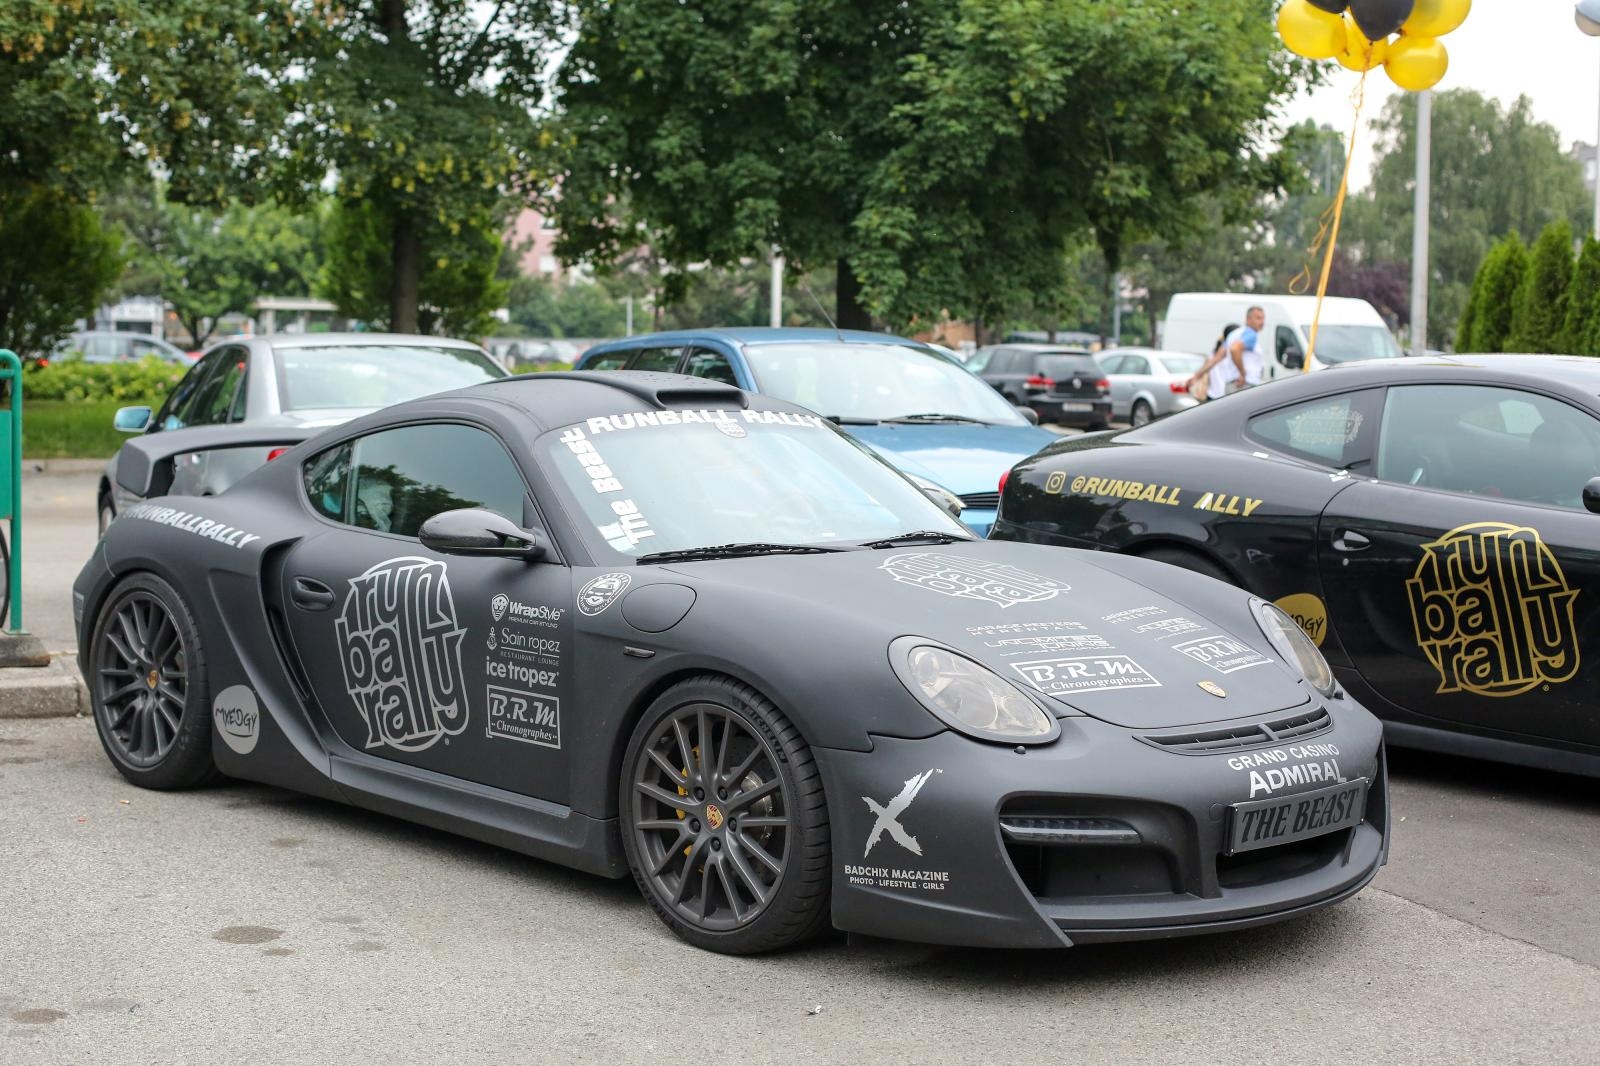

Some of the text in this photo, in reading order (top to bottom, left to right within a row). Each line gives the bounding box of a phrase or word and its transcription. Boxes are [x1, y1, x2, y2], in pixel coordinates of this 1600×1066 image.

[586, 409, 738, 434] RUNBALL
[740, 409, 825, 429] RALLY
[560, 427, 656, 546] The Beast
[1071, 475, 1181, 506] @RUNBALL
[501, 651, 560, 668] RESTAURANT LOUNGE
[1228, 743, 1340, 771] GRAND CASINO
[1249, 758, 1347, 799] ADMIRAL
[1241, 787, 1360, 844] THE BEAST
[844, 864, 950, 882] BADCHIX MAGAZINE
[849, 876, 945, 891] PHOTO LIFESTYLE GIRLS
